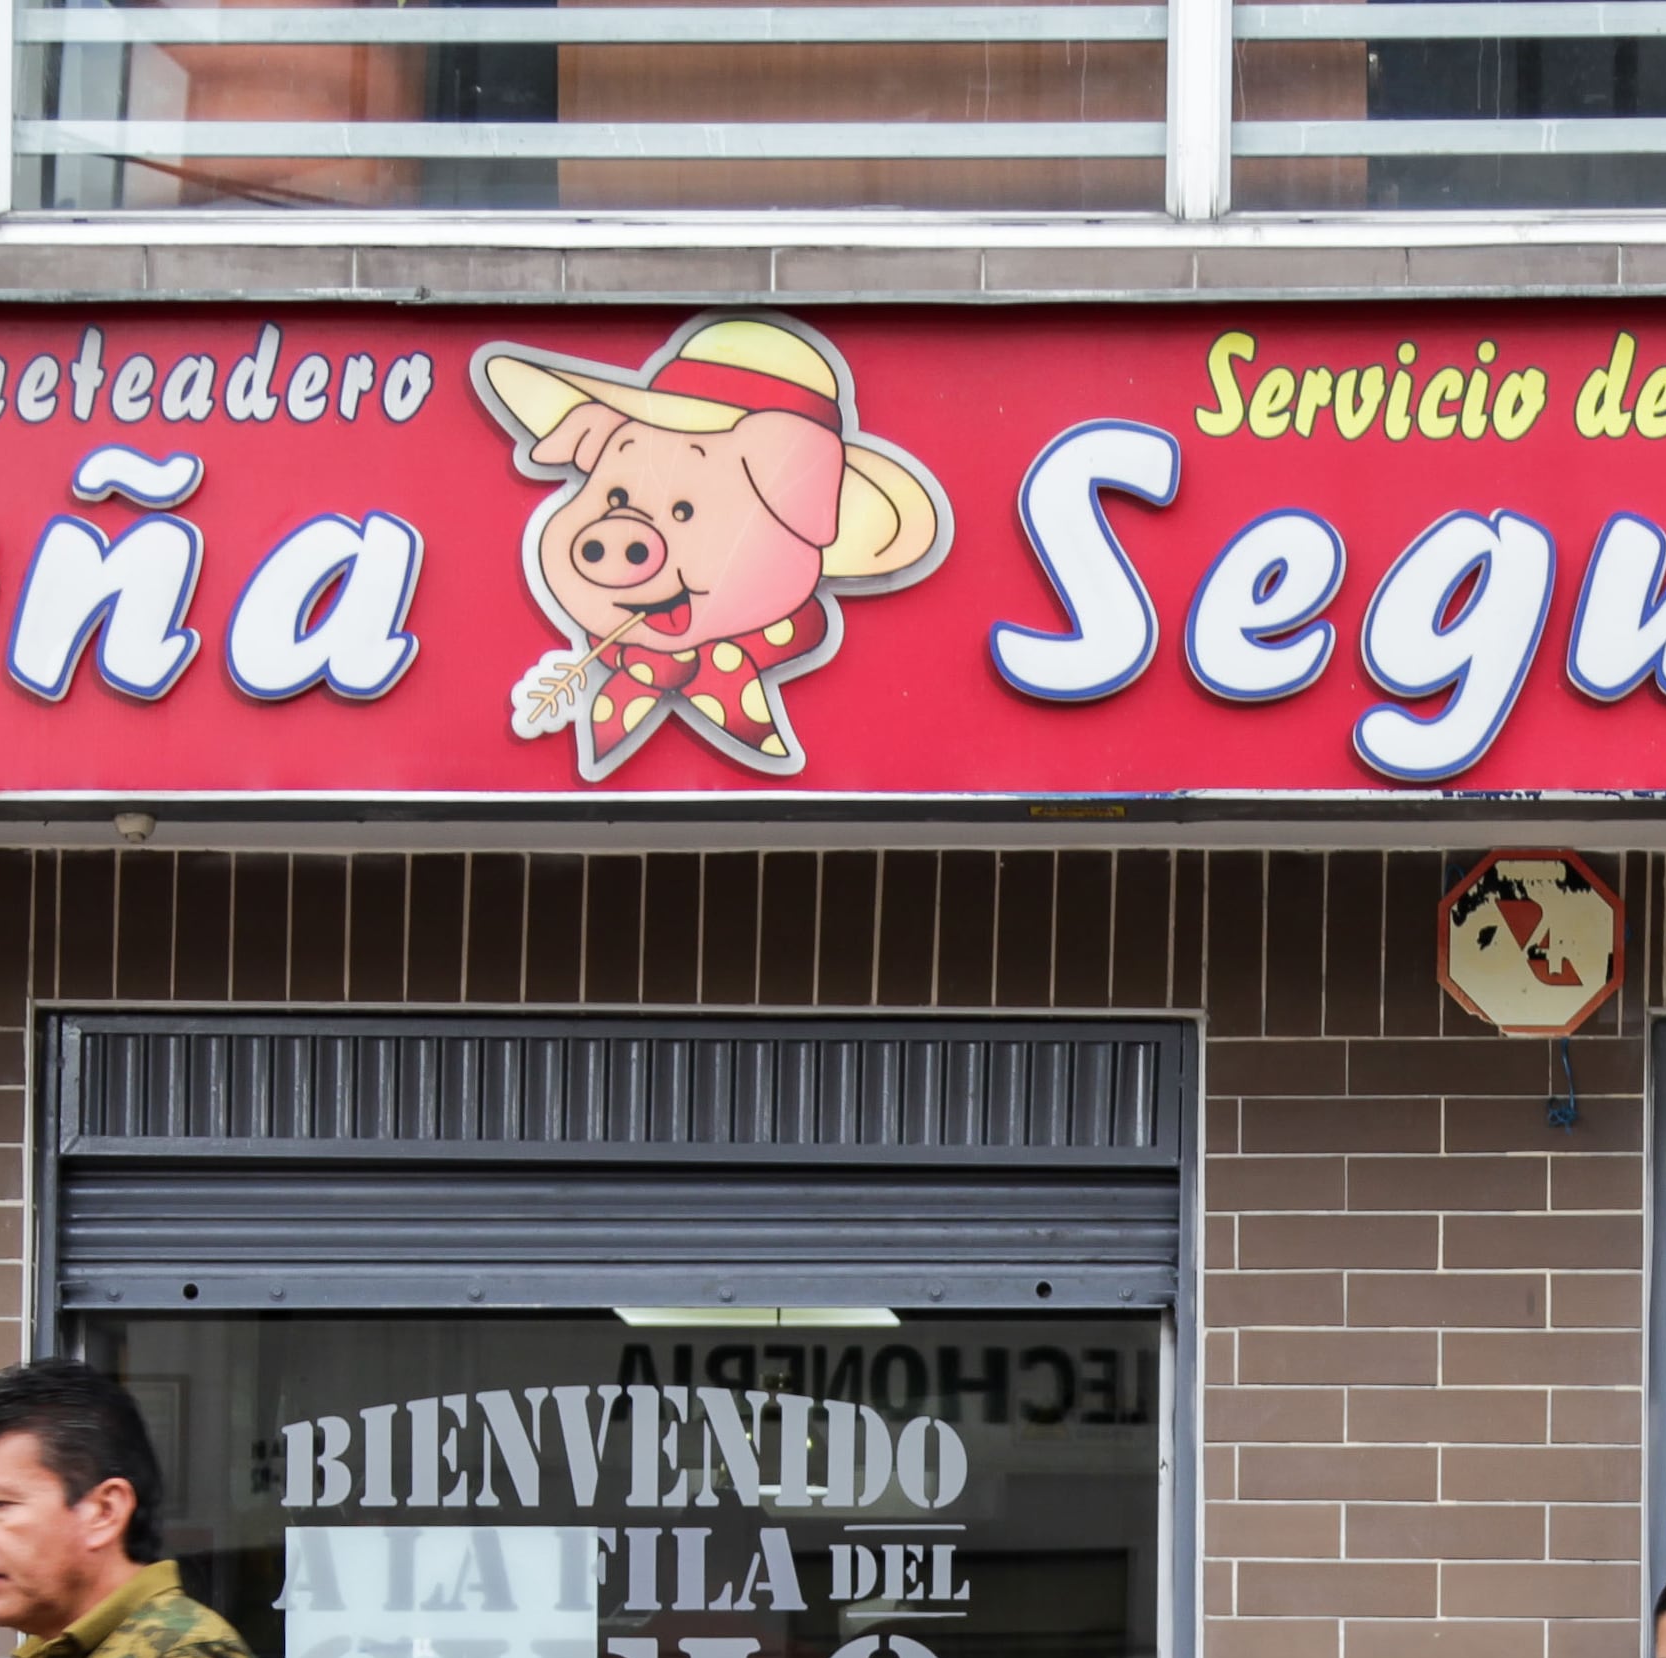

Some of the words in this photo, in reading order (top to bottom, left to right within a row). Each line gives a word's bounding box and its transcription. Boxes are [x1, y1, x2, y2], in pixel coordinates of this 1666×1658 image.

[1193, 328, 1549, 441] Servicio
[280, 1384, 968, 1508] BIENVENIDO
[273, 1527, 342, 1611] A
[381, 1527, 519, 1611] LA
[553, 1526, 808, 1611] FILA
[829, 1543, 970, 1602] DEL
